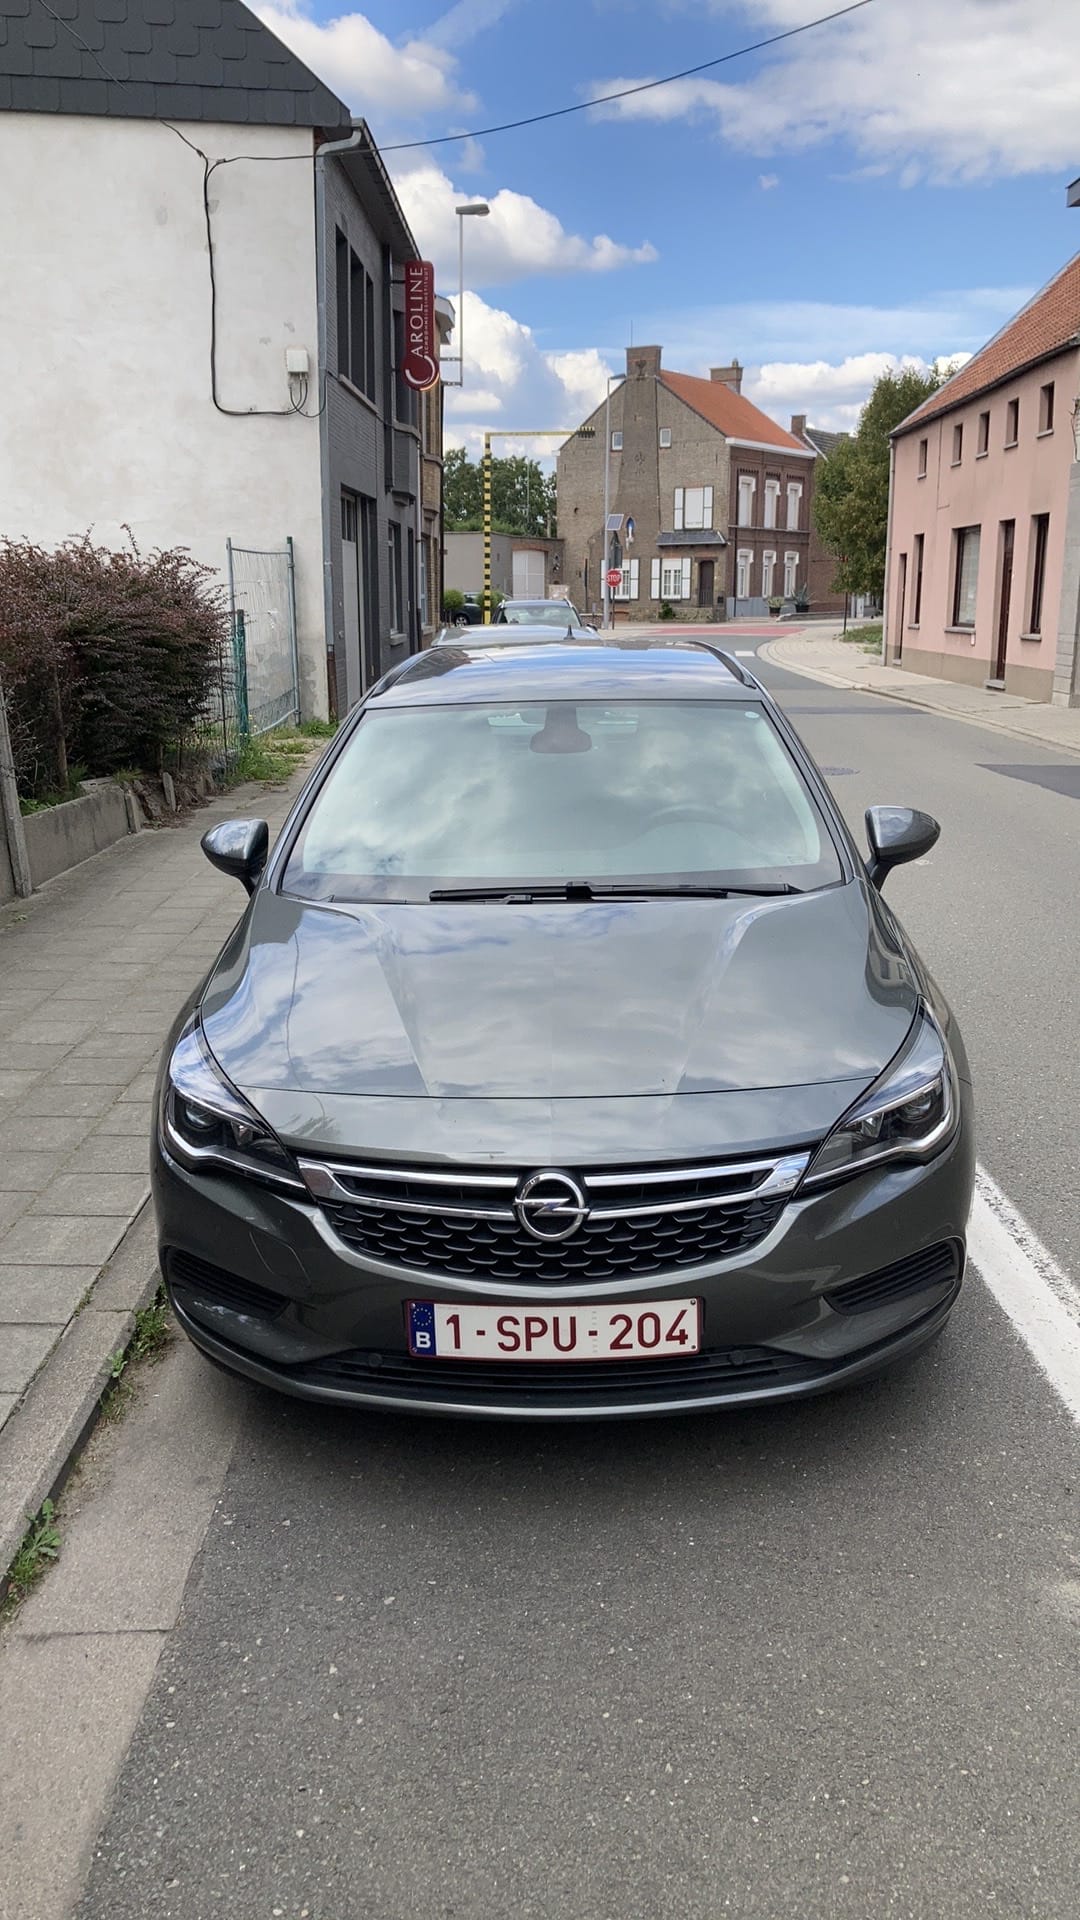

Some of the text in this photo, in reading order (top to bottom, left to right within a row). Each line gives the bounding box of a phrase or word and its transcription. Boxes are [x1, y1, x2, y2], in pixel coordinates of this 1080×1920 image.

[405, 267, 436, 384] CAROLINE
[607, 574, 621, 582] STOP
[416, 1331, 431, 1348] B
[446, 1309, 689, 1352] 1-SPU-204
